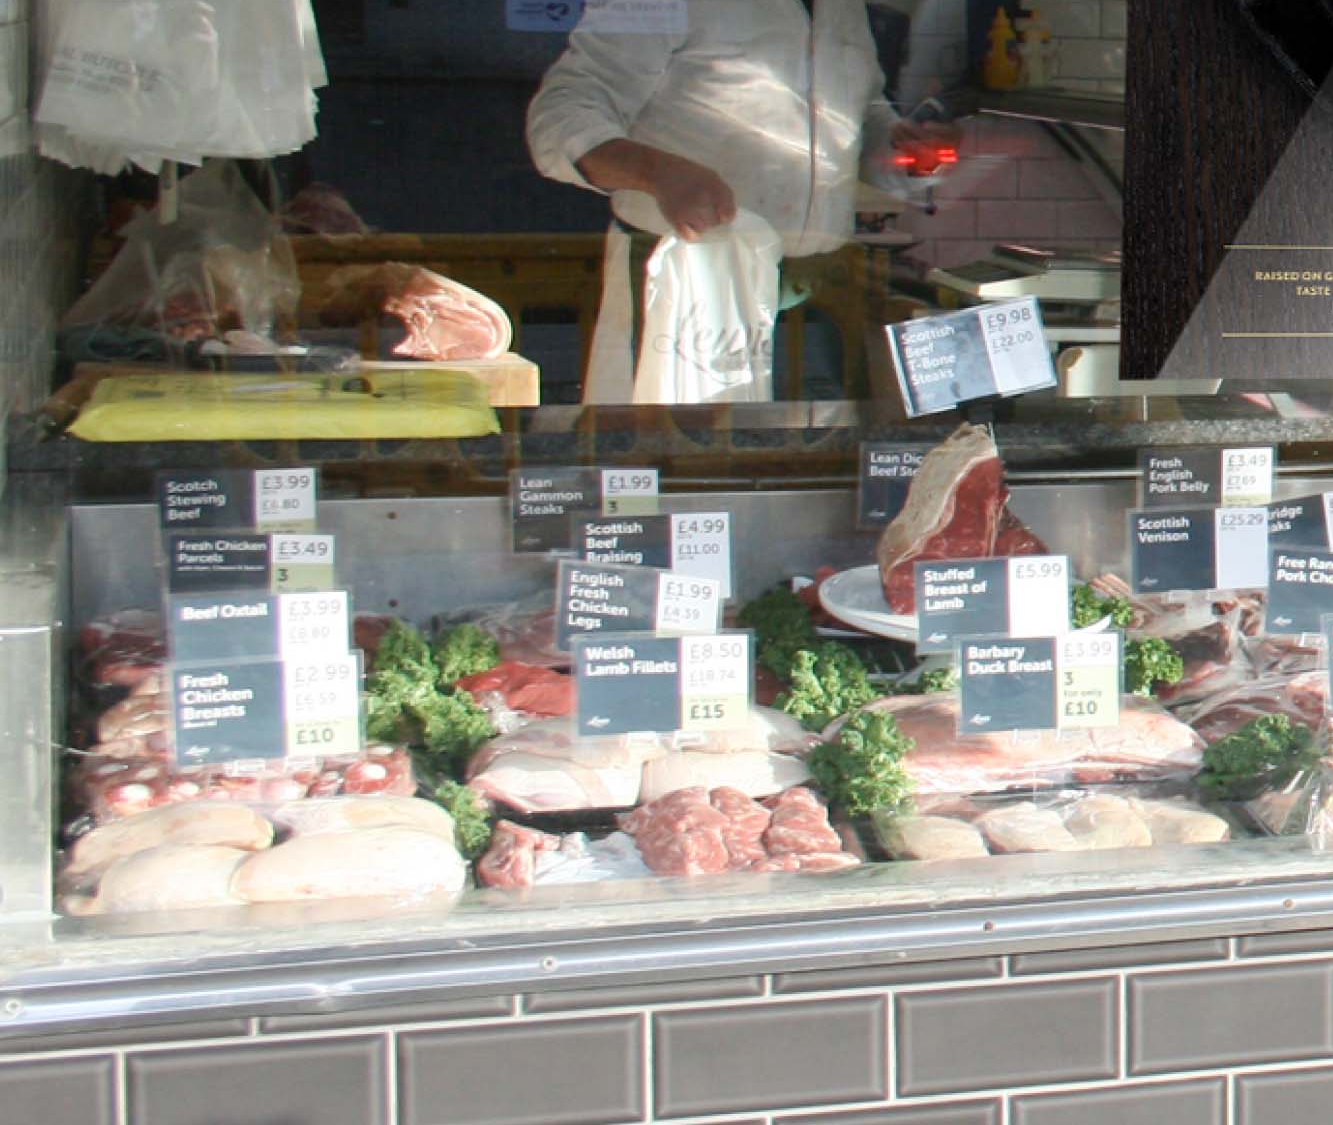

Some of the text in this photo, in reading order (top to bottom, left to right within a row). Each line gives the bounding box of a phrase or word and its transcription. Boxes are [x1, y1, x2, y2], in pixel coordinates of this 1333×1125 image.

[1255, 271, 1300, 281] RAISED
[1303, 271, 1321, 281] ON
[1296, 286, 1330, 296] TASTE
[901, 325, 955, 344] Scottish
[906, 342, 935, 357] Beef
[870, 452, 900, 463] Lean
[1150, 457, 1182, 468] Fresh
[870, 467, 897, 476] Beef
[1150, 469, 1193, 481] English
[167, 475, 310, 493] Scotch £3.99
[520, 476, 652, 491] Lean £1.99
[1150, 481, 1211, 494] Pork Belly
[168, 494, 226, 508] Stewing
[520, 491, 584, 503] Gammon
[168, 509, 201, 520] Beef
[520, 501, 618, 515] Steaks 3
[586, 519, 725, 536] Scottish £4.99
[1138, 516, 1190, 530] Scottish
[586, 537, 618, 549] Beef
[1138, 531, 1189, 543] Venison
[178, 540, 328, 556] Fresh Chicken £3.49
[178, 553, 224, 563] Parcels
[278, 568, 289, 581] 3
[1278, 555, 1306, 567] Free
[924, 563, 1062, 582] Stuffed £5.99
[1276, 569, 1306, 582] Pork
[570, 571, 713, 600] English £1.99
[570, 584, 610, 599] Fresh
[925, 581, 987, 596] Breast of
[181, 600, 341, 620] Beef £3.99
[569, 599, 629, 616] Chicken
[925, 598, 965, 612] Lamb
[569, 614, 603, 630] Legs
[586, 643, 743, 661] Welsh £8.50
[968, 645, 1025, 660] Barbary
[587, 660, 678, 676] Lamb Fillets
[968, 659, 1053, 674] Duck Breast
[182, 673, 229, 687] Fresh
[1064, 672, 1074, 686] 3
[182, 688, 253, 704] Chicken
[182, 706, 246, 721] Breasts
[690, 704, 724, 720] £15
[1065, 700, 1098, 716] £10
[296, 728, 335, 745] £10
